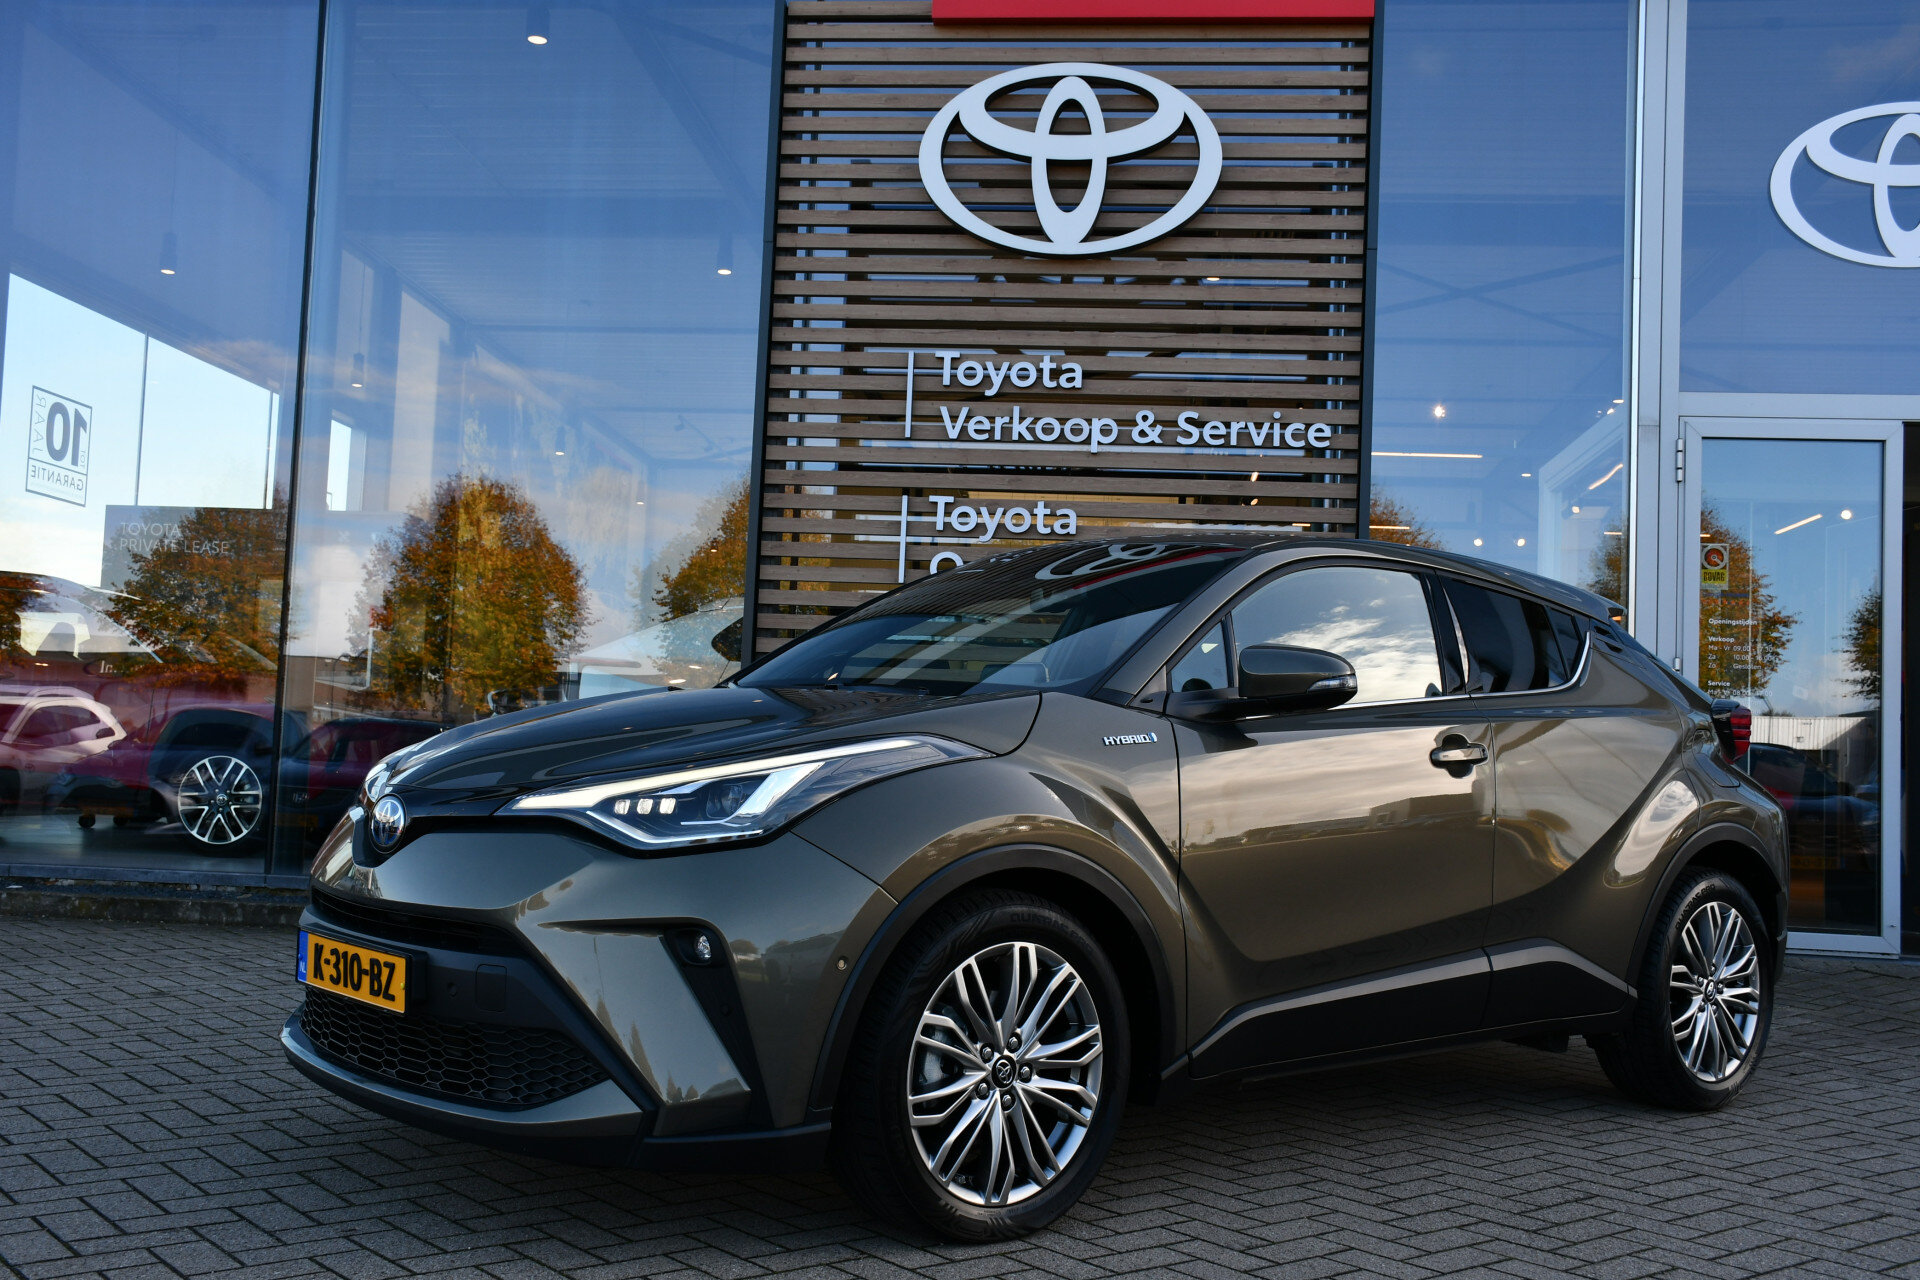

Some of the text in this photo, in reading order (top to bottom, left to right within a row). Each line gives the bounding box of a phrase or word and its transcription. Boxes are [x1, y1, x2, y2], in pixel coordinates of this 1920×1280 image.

[935, 350, 1084, 397] Toyota
[940, 405, 1332, 454] Verkoop & Service
[928, 494, 1078, 543] Toyota
[120, 522, 182, 536] TOYOTA
[119, 538, 229, 554] PRIVATE LEASE
[1708, 617, 1758, 626] Openingstijden
[1708, 636, 1735, 644] Verkoop
[1103, 734, 1151, 746] HYBRID
[299, 942, 396, 1002] NL K-310-BZ
